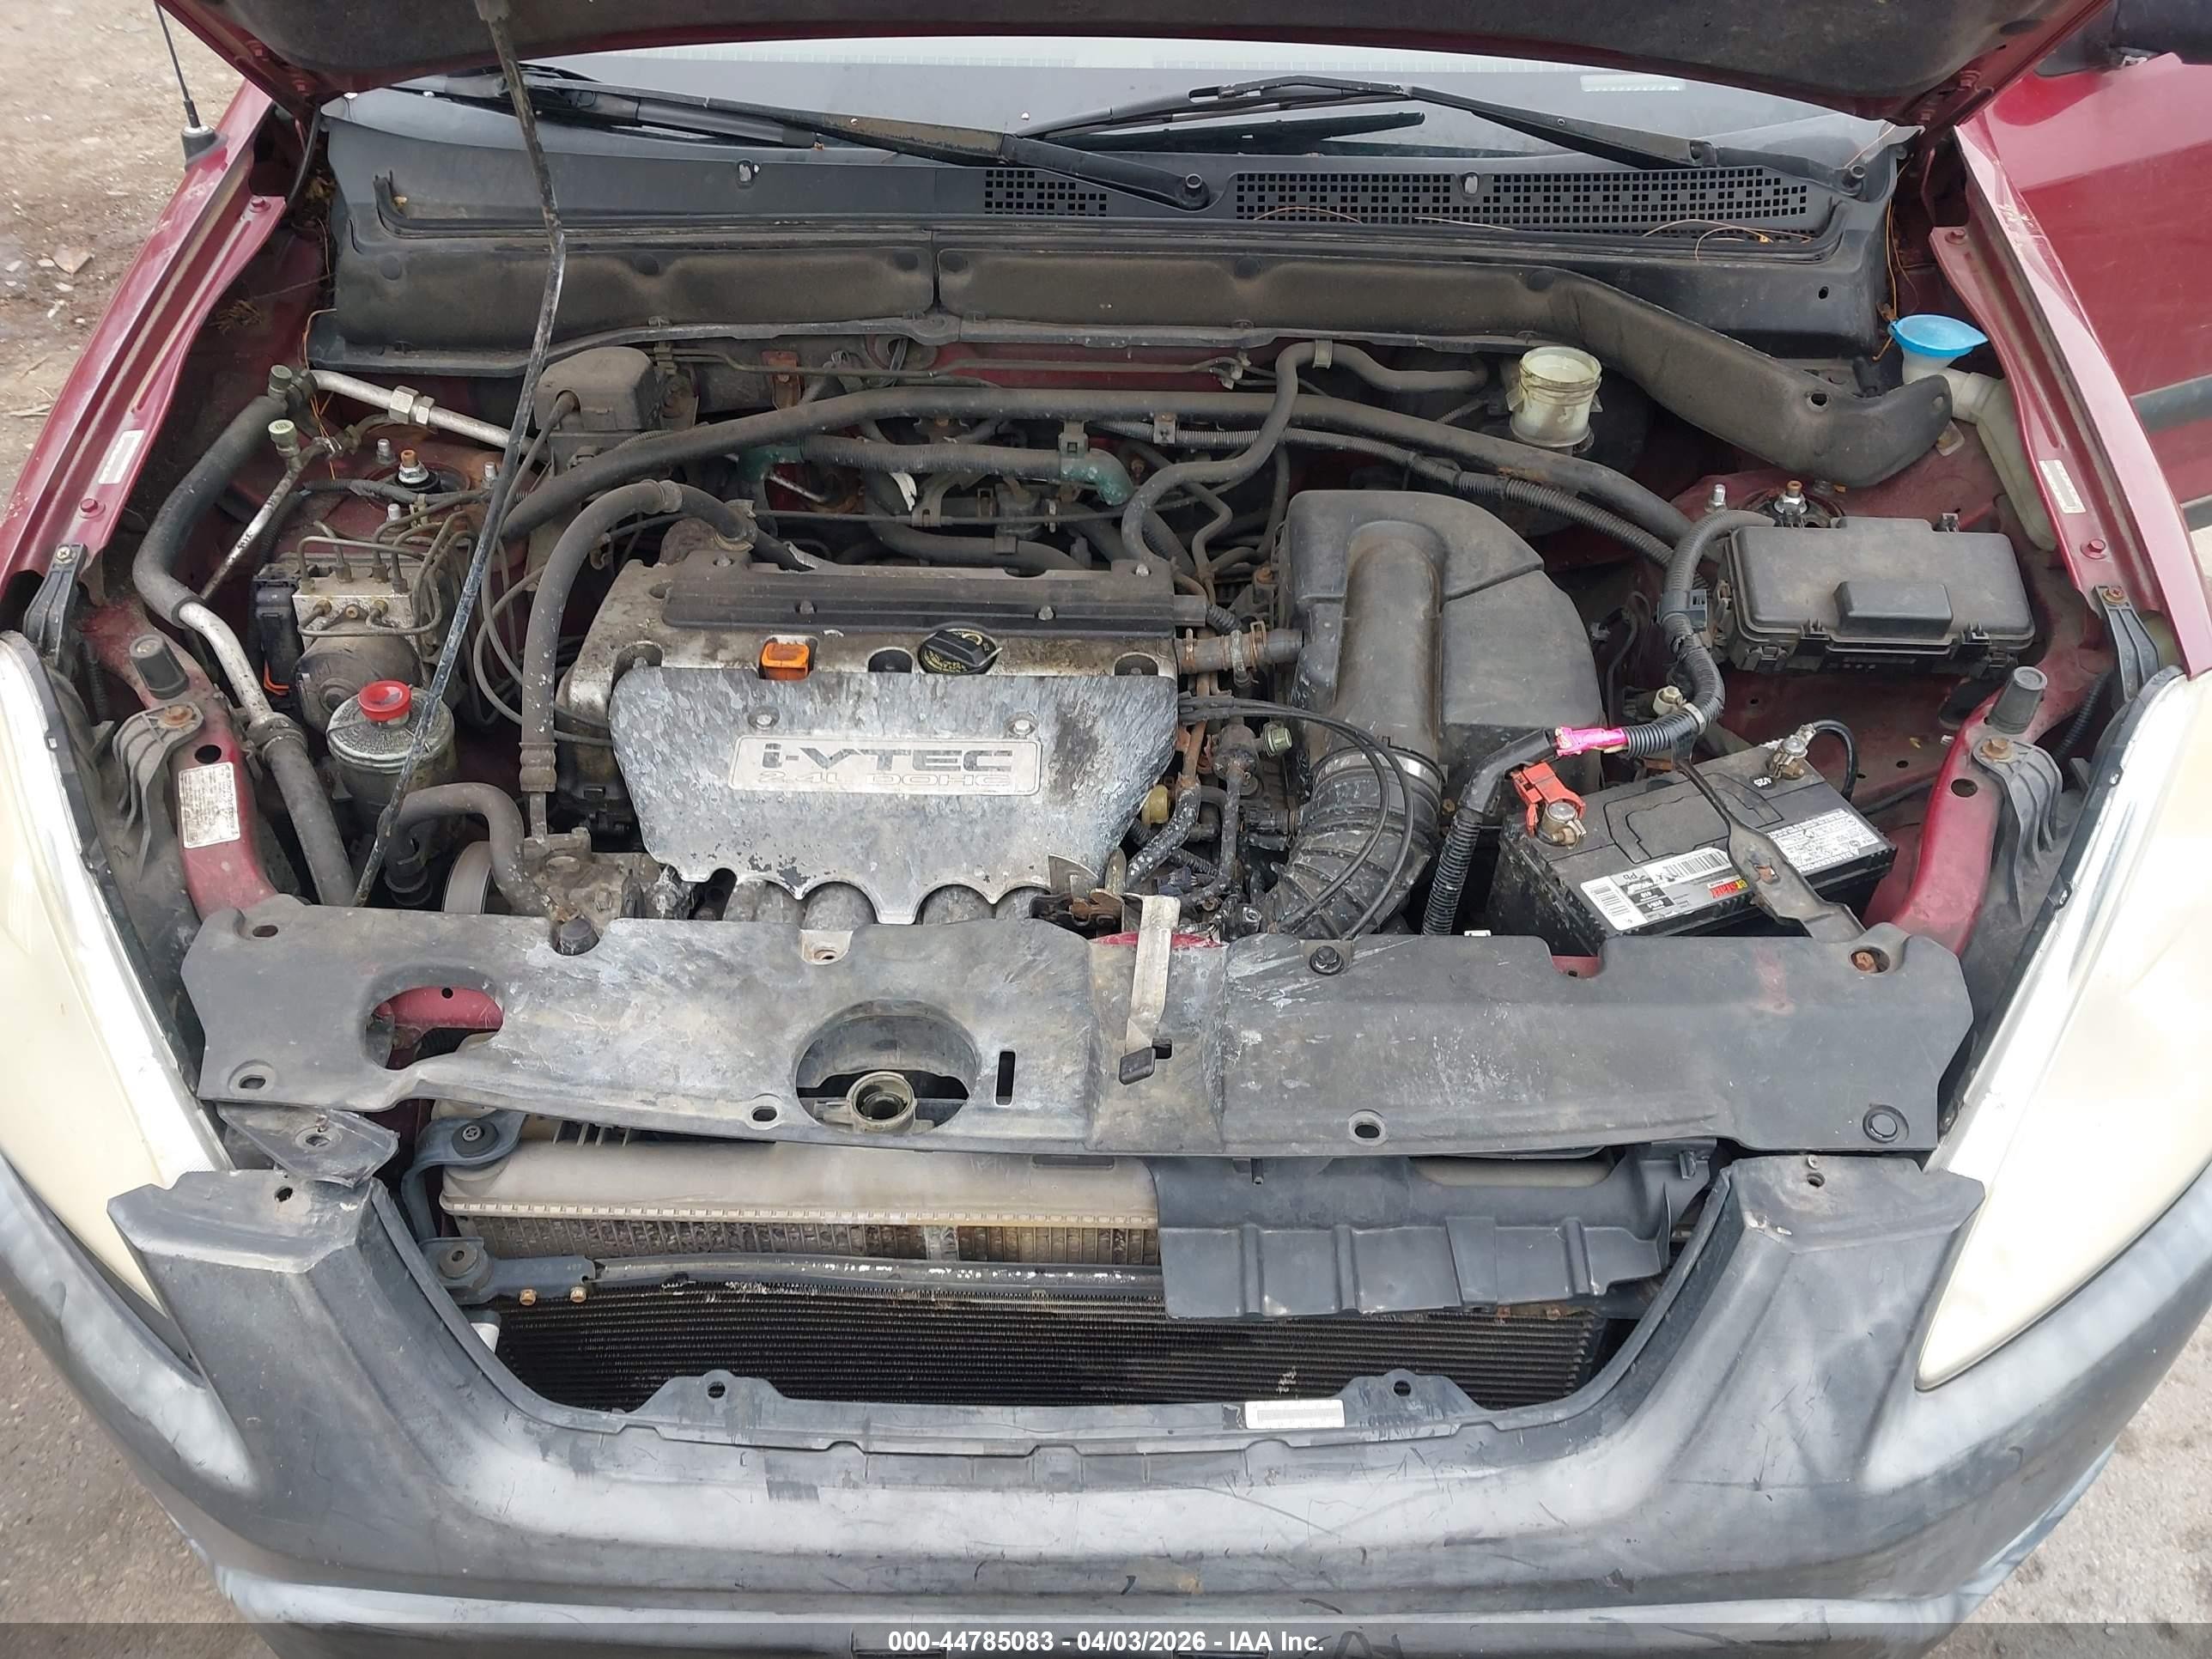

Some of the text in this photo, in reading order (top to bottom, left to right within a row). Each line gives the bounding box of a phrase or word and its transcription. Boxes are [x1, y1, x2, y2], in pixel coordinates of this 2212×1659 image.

[762, 742, 1013, 772] i-VTEC
[757, 771, 1012, 786] 2.4L DOHC
